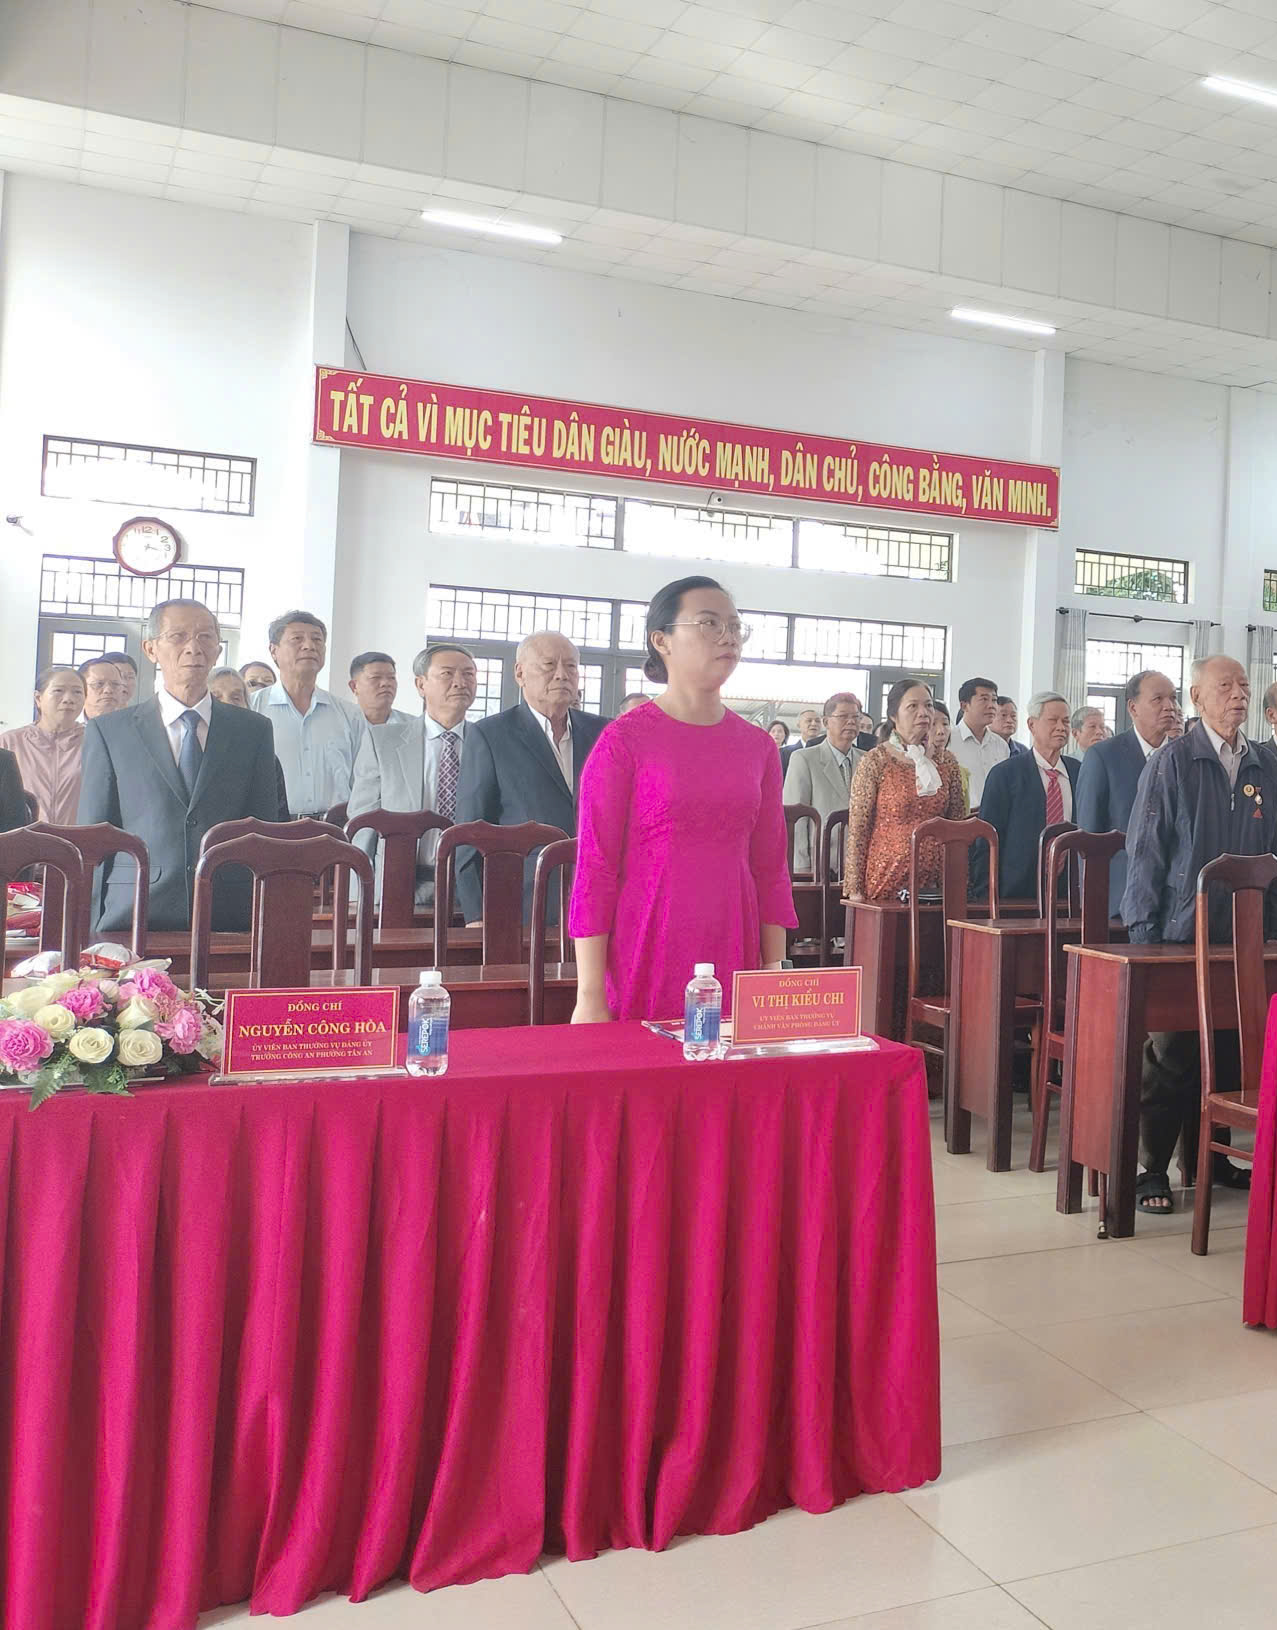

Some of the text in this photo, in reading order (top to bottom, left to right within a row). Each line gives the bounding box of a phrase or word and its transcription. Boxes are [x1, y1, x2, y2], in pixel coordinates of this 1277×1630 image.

[330, 378, 1052, 517] TẤT CẢ VÌ MỤC TIÊU DÂN GIÀU, NƯỚC MẠNH, DÂN CHỦ, CÔNG BẰNG, VĂN MINH.
[142, 526, 153, 534] 12
[160, 536, 169, 544] 2
[164, 544, 171, 552] 3
[752, 995, 765, 1009] VI
[768, 994, 789, 1010] THỊ
[823, 992, 845, 1005] CHI
[322, 1000, 343, 1012] CHÍ
[239, 1018, 387, 1038] NGUYỄN CÔNG HÒA
[282, 1043, 298, 1051] BAN
[304, 1051, 316, 1059] AN
